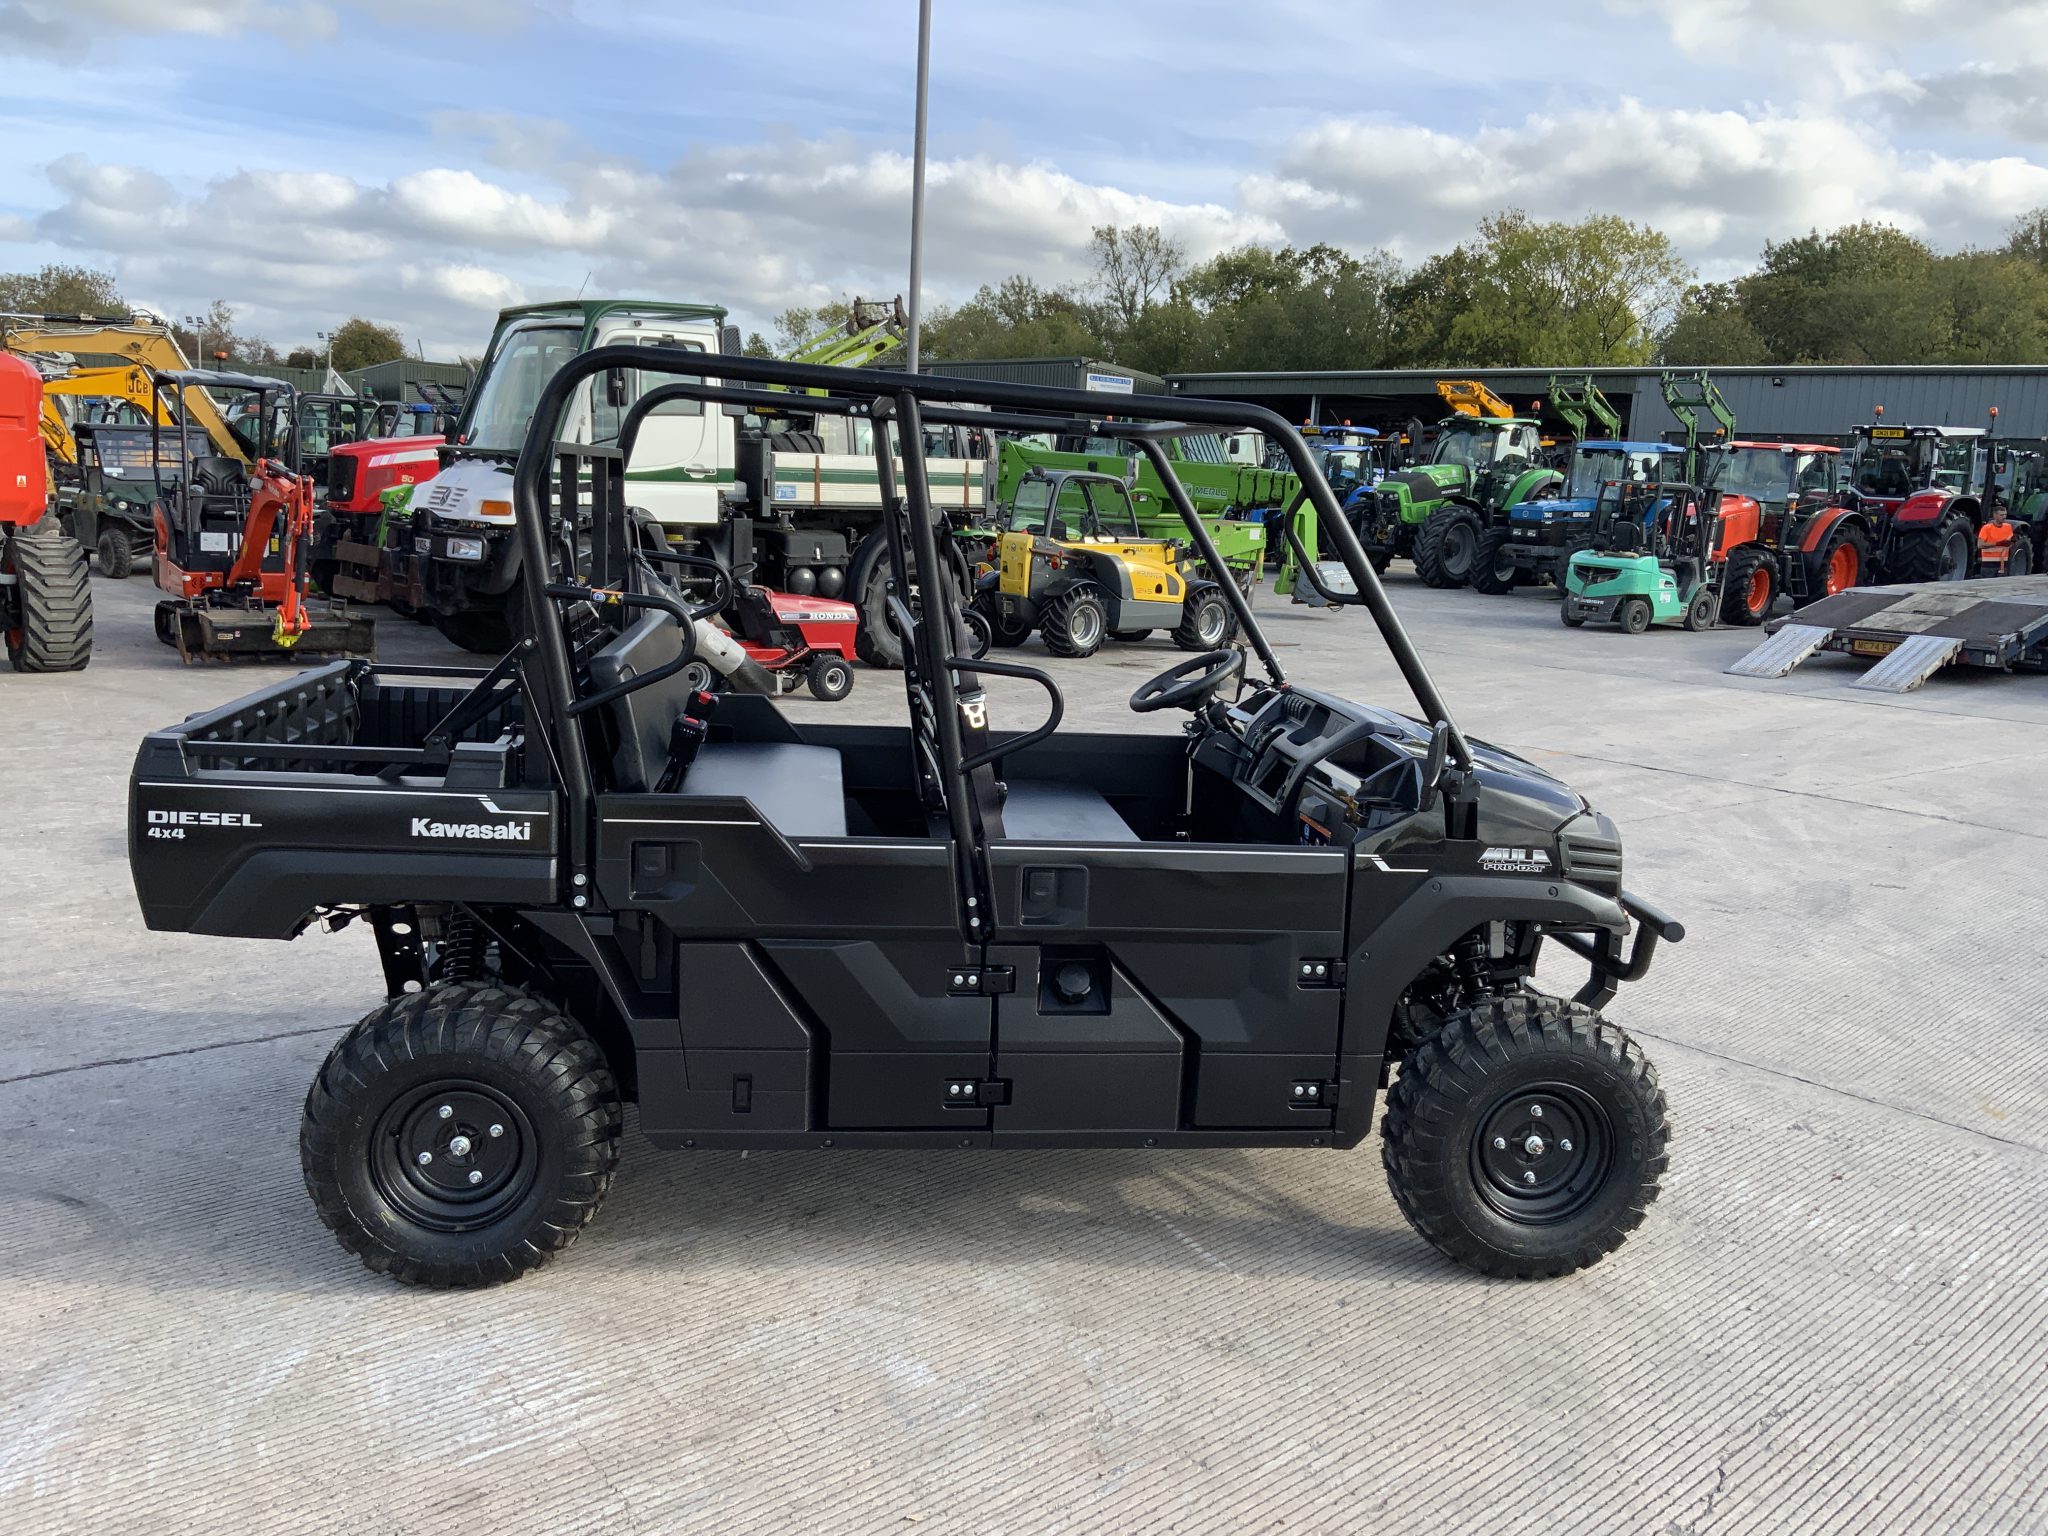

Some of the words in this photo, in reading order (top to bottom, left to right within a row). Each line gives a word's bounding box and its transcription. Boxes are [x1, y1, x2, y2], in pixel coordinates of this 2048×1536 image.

[128, 379, 148, 394] JCB
[1195, 487, 1228, 497] MERLO
[810, 612, 850, 620] HONDA
[147, 810, 263, 827] DIESEL
[147, 827, 186, 839] 4x4
[411, 817, 531, 840] Kawasaki
